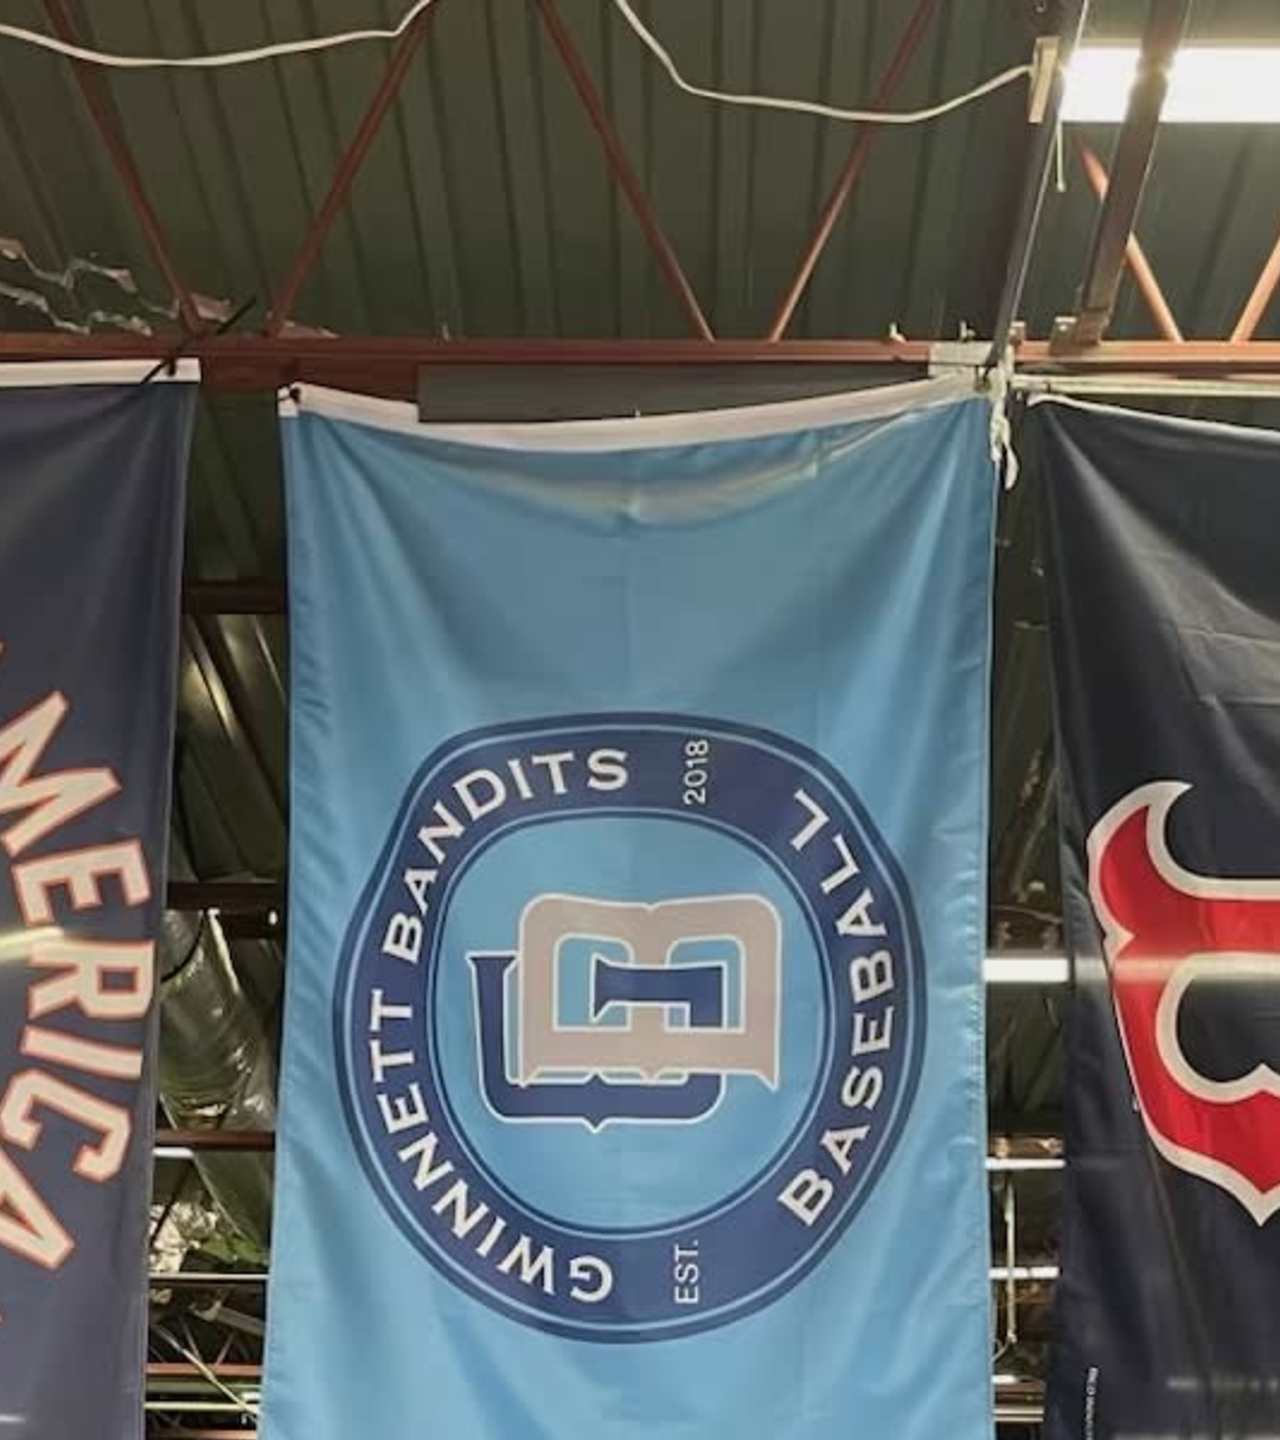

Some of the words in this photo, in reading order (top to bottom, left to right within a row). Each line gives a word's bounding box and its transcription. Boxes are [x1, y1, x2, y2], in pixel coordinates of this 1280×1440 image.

[381, 747, 630, 964] BANDITS
[682, 738, 710, 806] 2018
[777, 788, 896, 1228] BASEBALL
[368, 988, 615, 1303] GWINNETT
[674, 1237, 702, 1304] EST.
